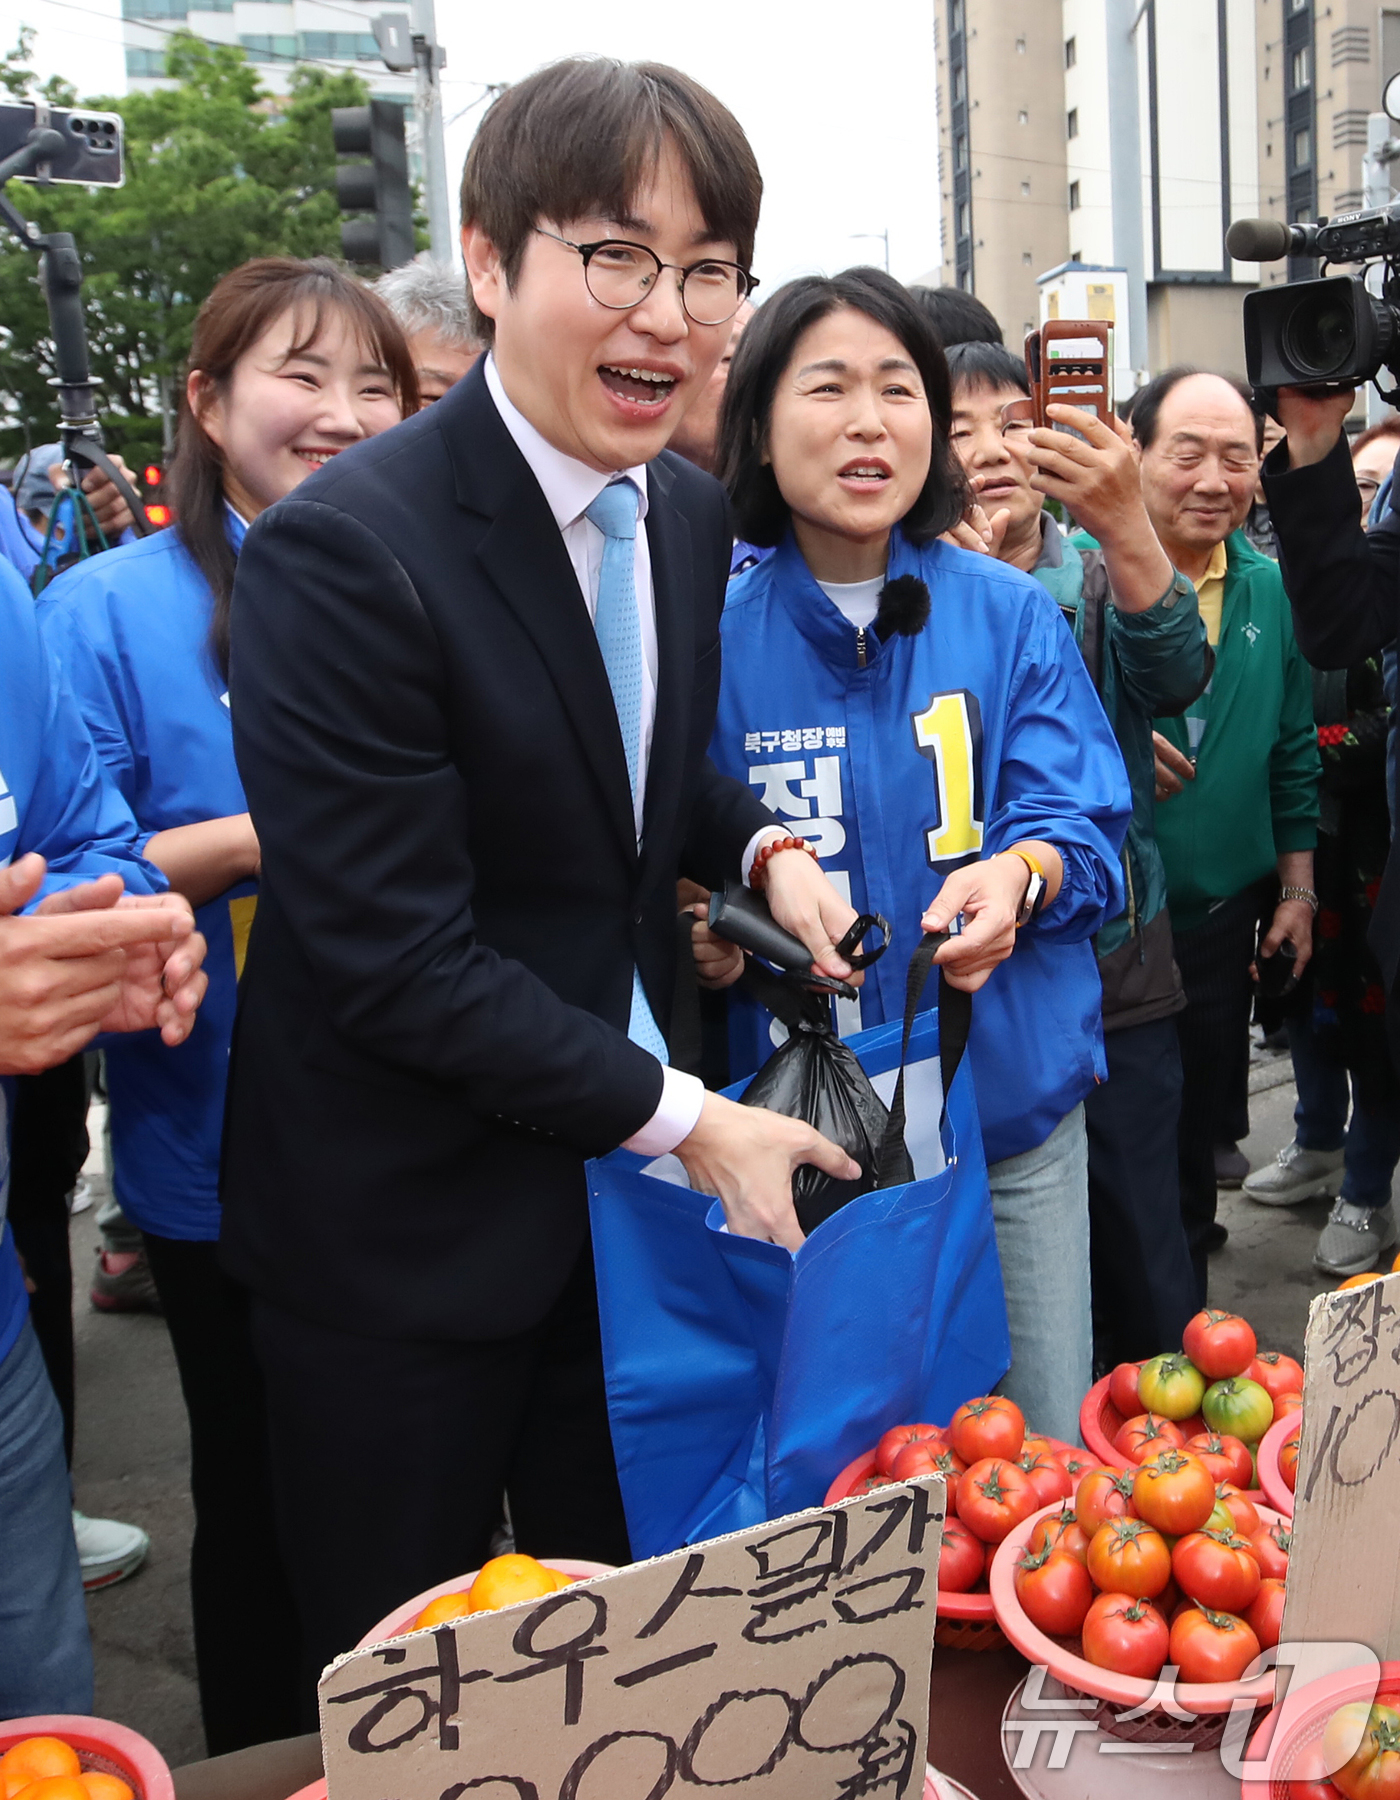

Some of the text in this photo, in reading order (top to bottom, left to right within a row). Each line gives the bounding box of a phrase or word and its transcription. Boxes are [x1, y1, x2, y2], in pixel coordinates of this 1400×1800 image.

[744, 726, 825, 754] 북구청장
[825, 737, 846, 749] 후보
[911, 689, 985, 874] 1
